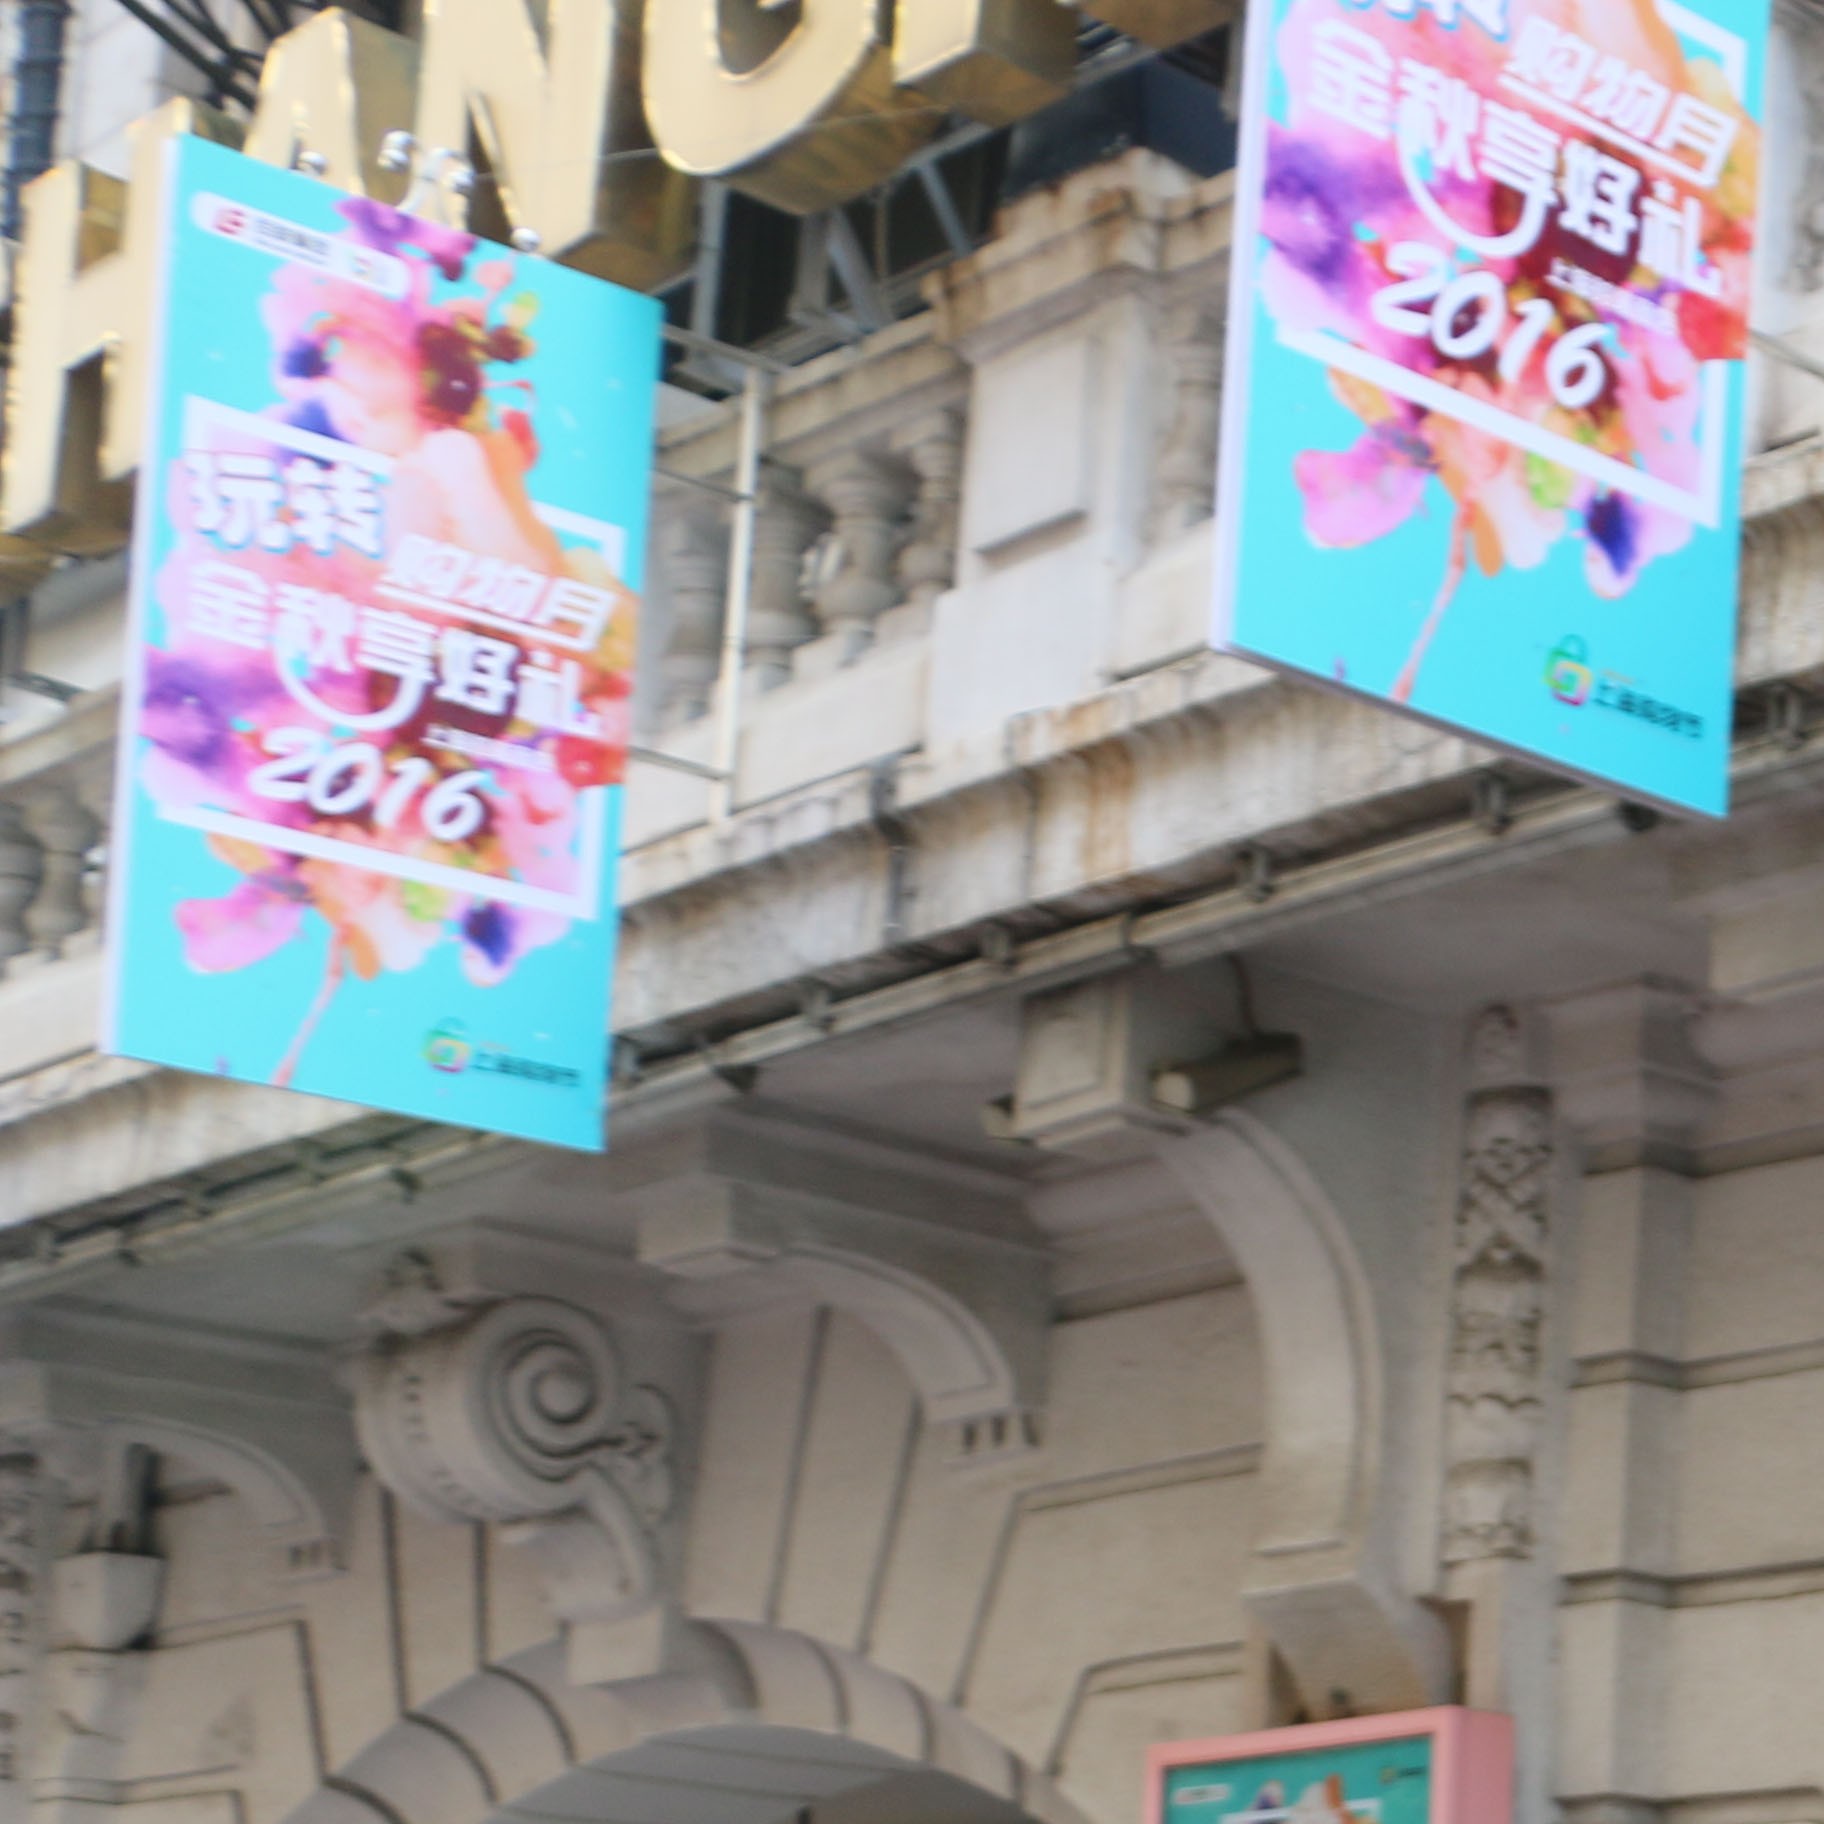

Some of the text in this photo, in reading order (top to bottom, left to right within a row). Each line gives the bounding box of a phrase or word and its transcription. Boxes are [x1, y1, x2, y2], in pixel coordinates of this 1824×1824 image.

[1308, 18, 1723, 298] 金秋享好礼
[1508, 15, 1740, 188] 购物月
[1371, 242, 1606, 409] 2016
[183, 444, 386, 562] 玩转
[185, 560, 602, 740] 金秋享好礼
[376, 532, 615, 656] 购物月
[248, 726, 492, 845] 2016
